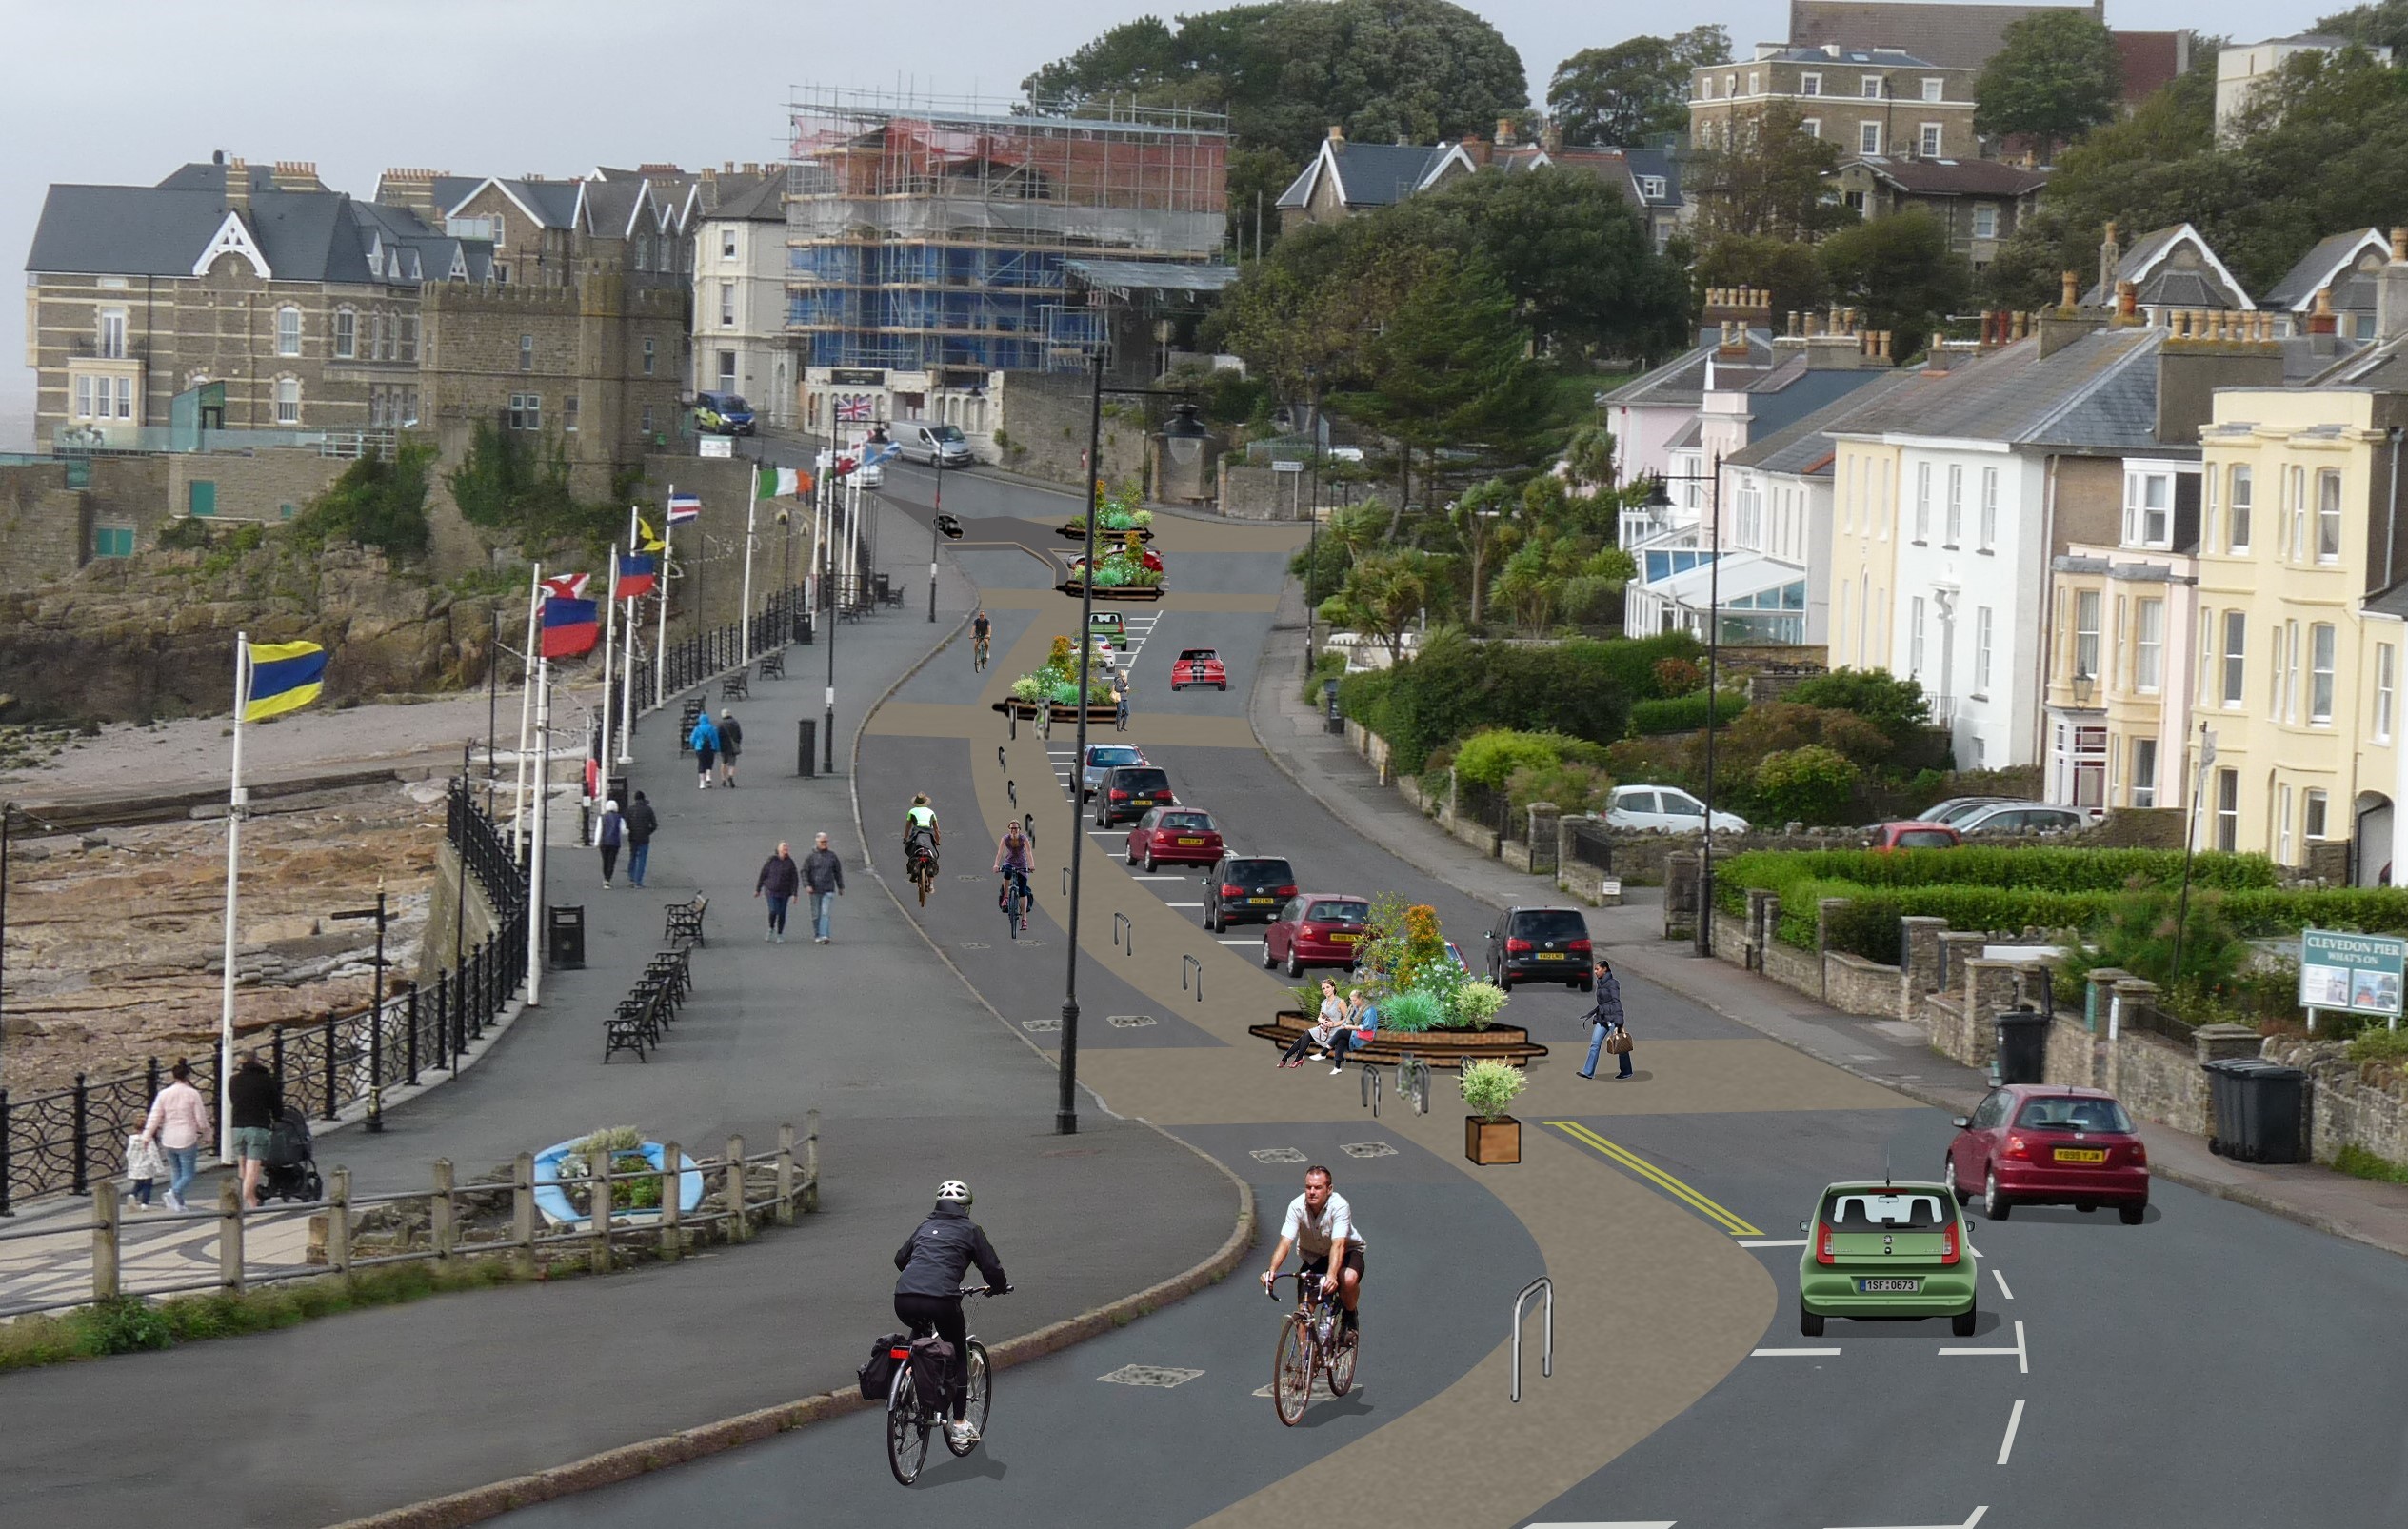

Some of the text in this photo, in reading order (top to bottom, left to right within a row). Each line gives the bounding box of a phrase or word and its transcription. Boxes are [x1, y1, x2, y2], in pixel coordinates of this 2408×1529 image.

[2307, 937, 2400, 956] CLEVEDON PIER
[2327, 951, 2379, 964] WHAT'S ON
